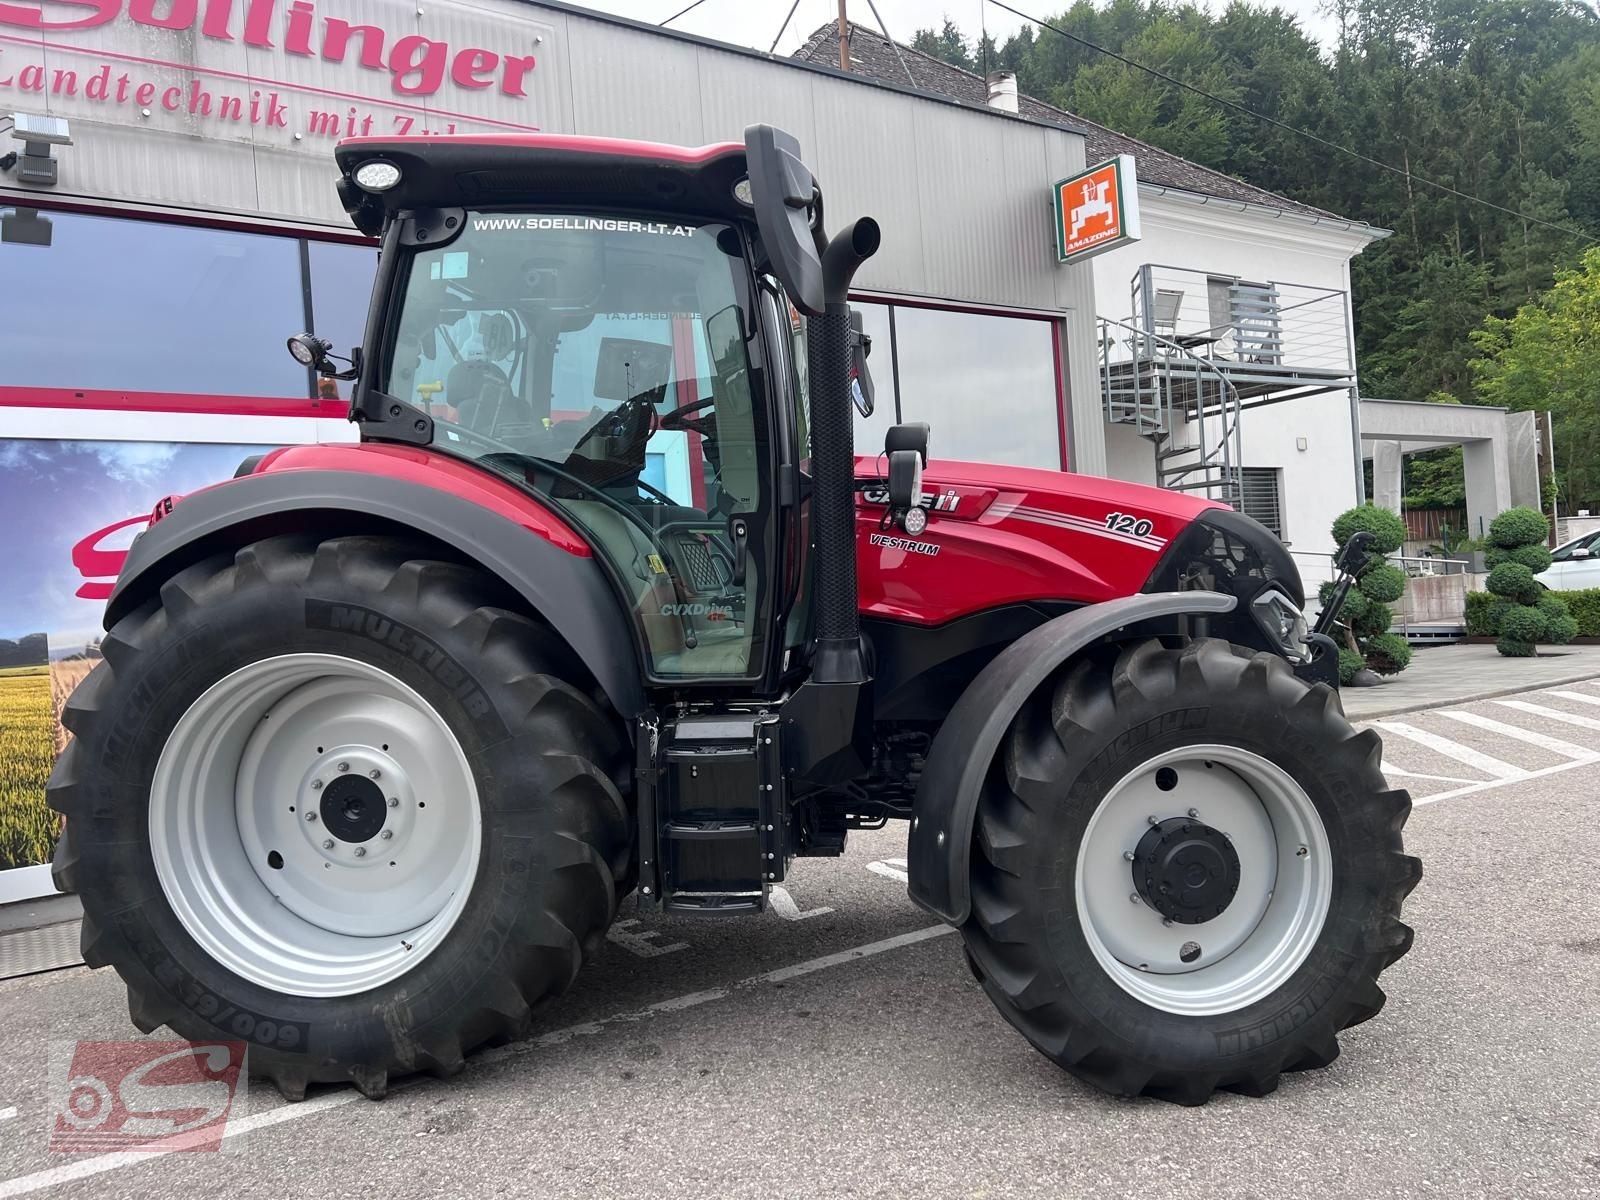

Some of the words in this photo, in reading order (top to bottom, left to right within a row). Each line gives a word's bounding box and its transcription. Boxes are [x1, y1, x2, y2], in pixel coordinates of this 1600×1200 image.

[309, 107, 374, 137] mit
[473, 218, 696, 237] WWW.SOELLINGER-LT.AT
[1067, 227, 1118, 250] AMAZONE
[1105, 512, 1154, 537] 120
[869, 533, 941, 557] VESTRUM
[661, 602, 733, 617] CVXDrive
[329, 605, 491, 720] MULTIBIB
